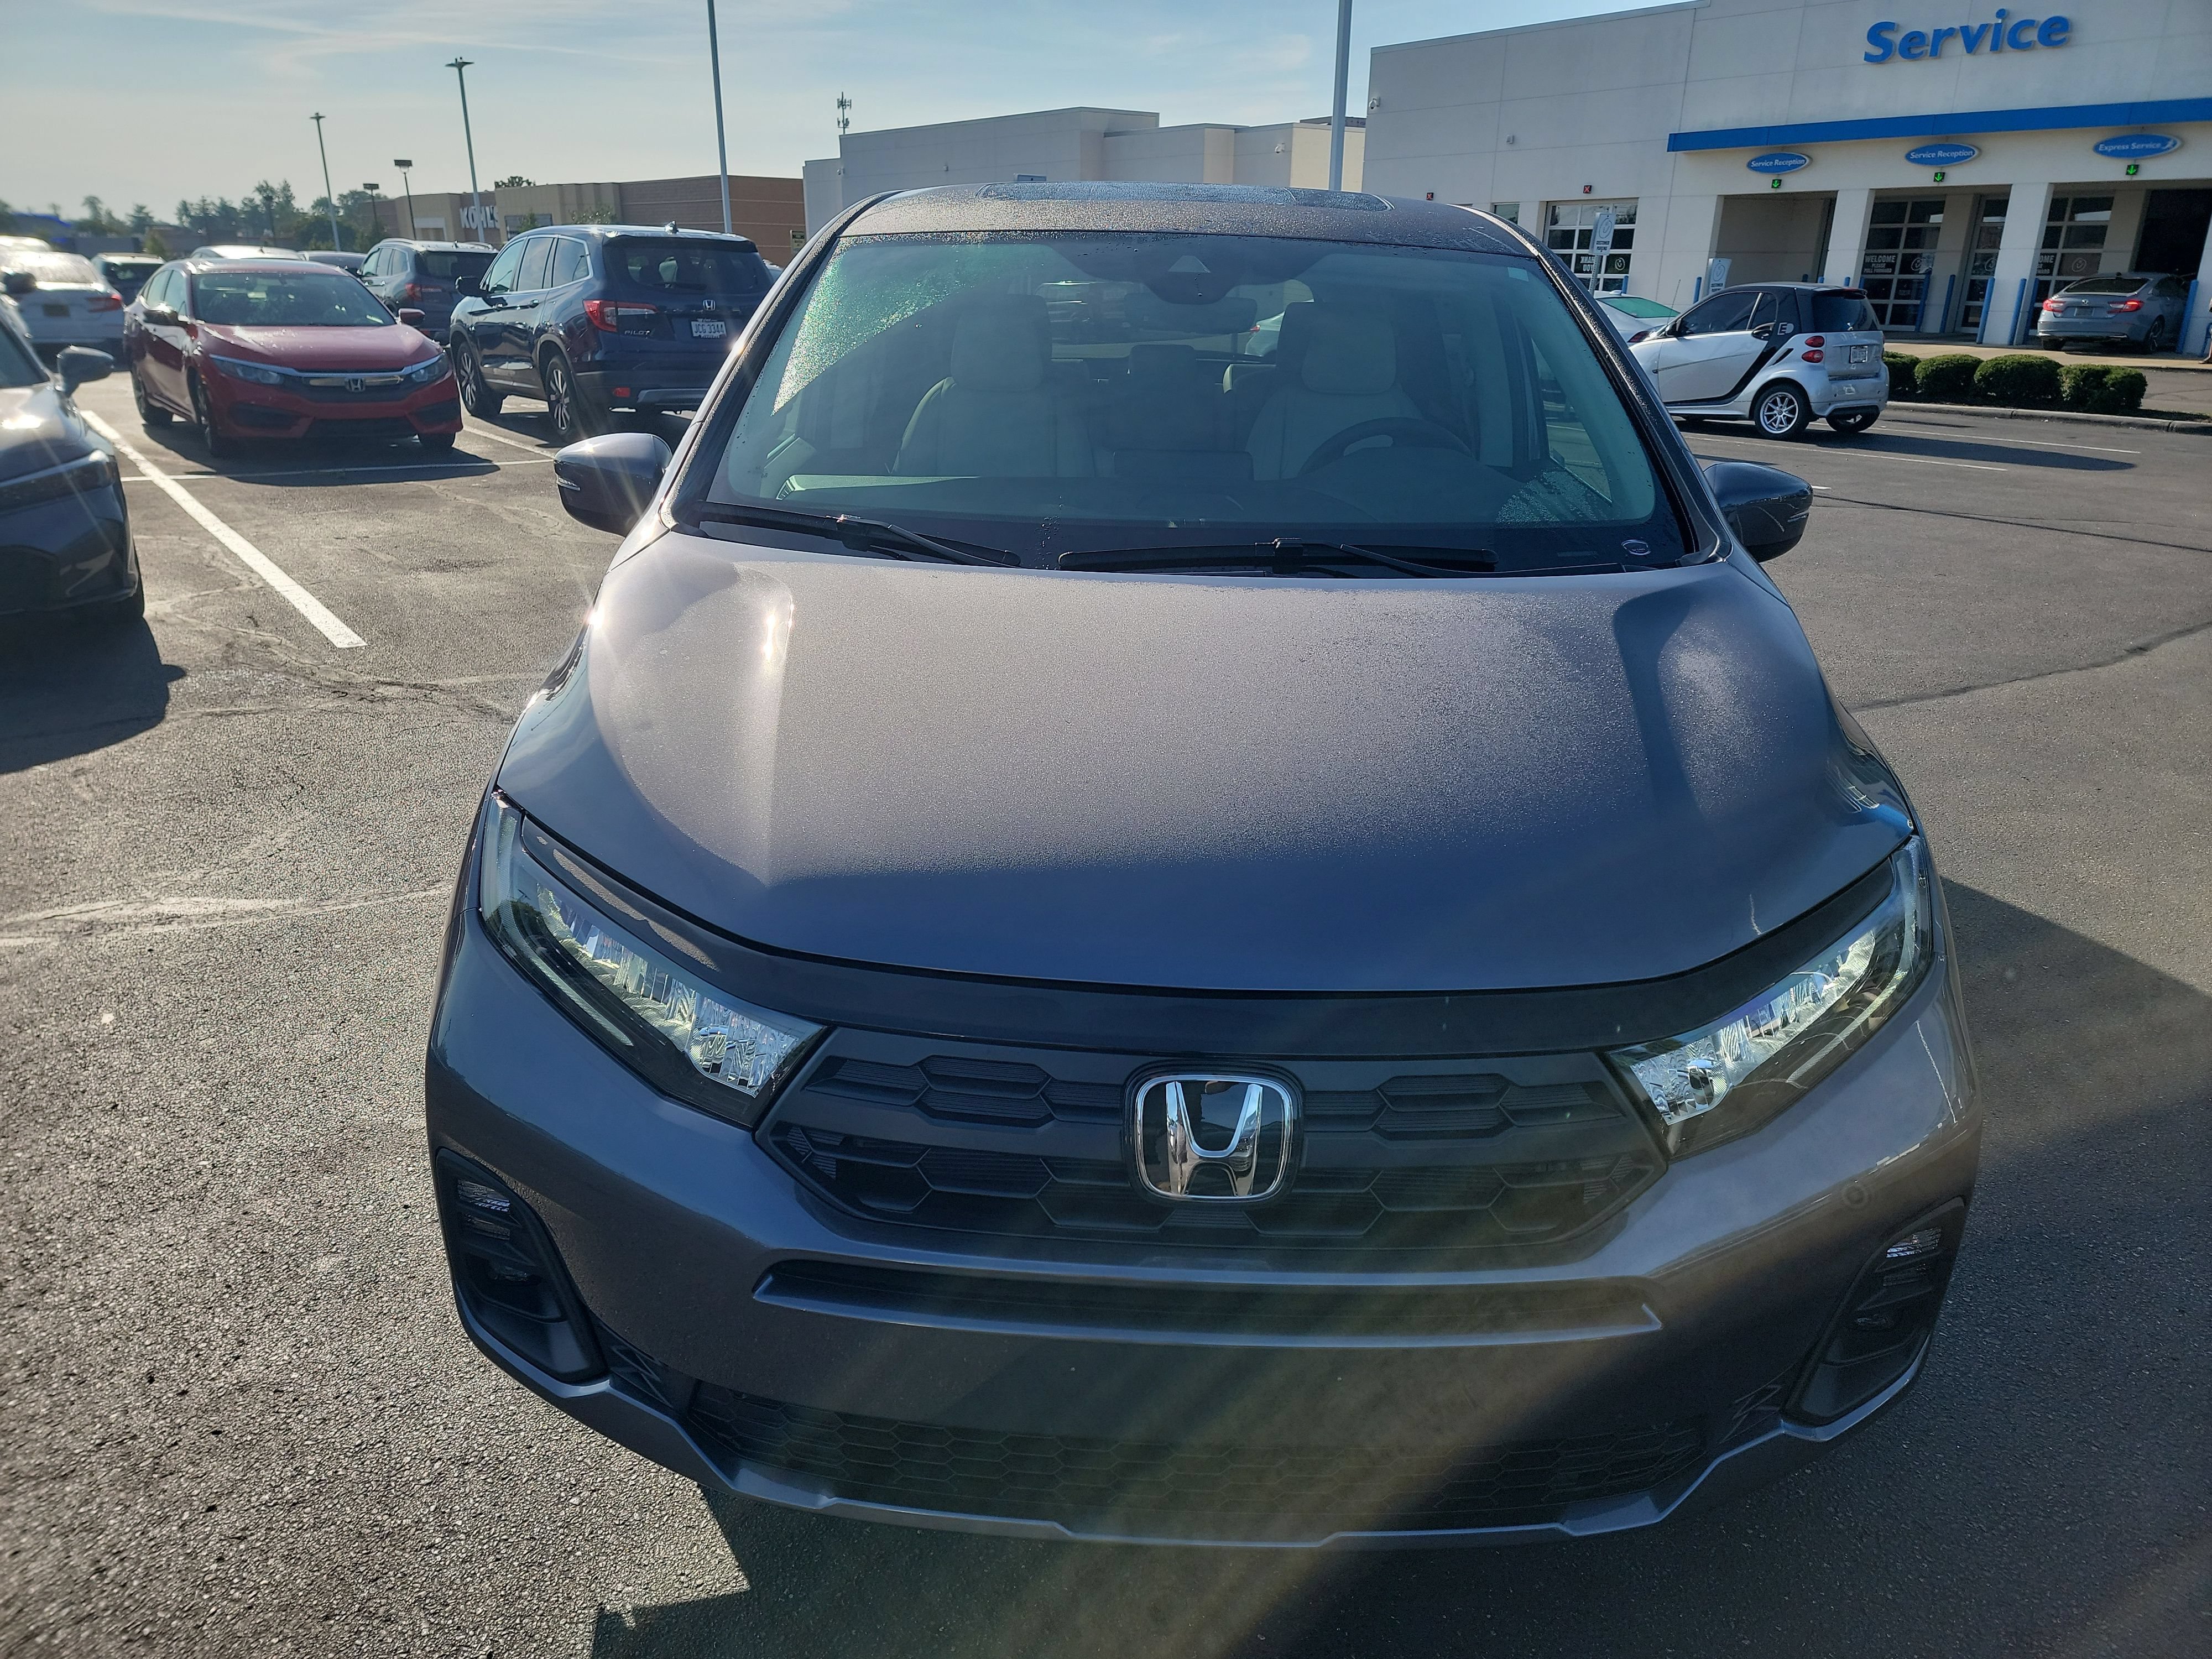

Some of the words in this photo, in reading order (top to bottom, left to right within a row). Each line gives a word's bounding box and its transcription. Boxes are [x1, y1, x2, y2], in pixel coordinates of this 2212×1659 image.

[1864, 8, 2070, 63] Service
[2099, 143, 2129, 152] Express
[2131, 142, 2162, 150] Service
[1937, 149, 1973, 158] Reception
[1751, 159, 1773, 168] Service
[1774, 158, 1806, 166] Reception
